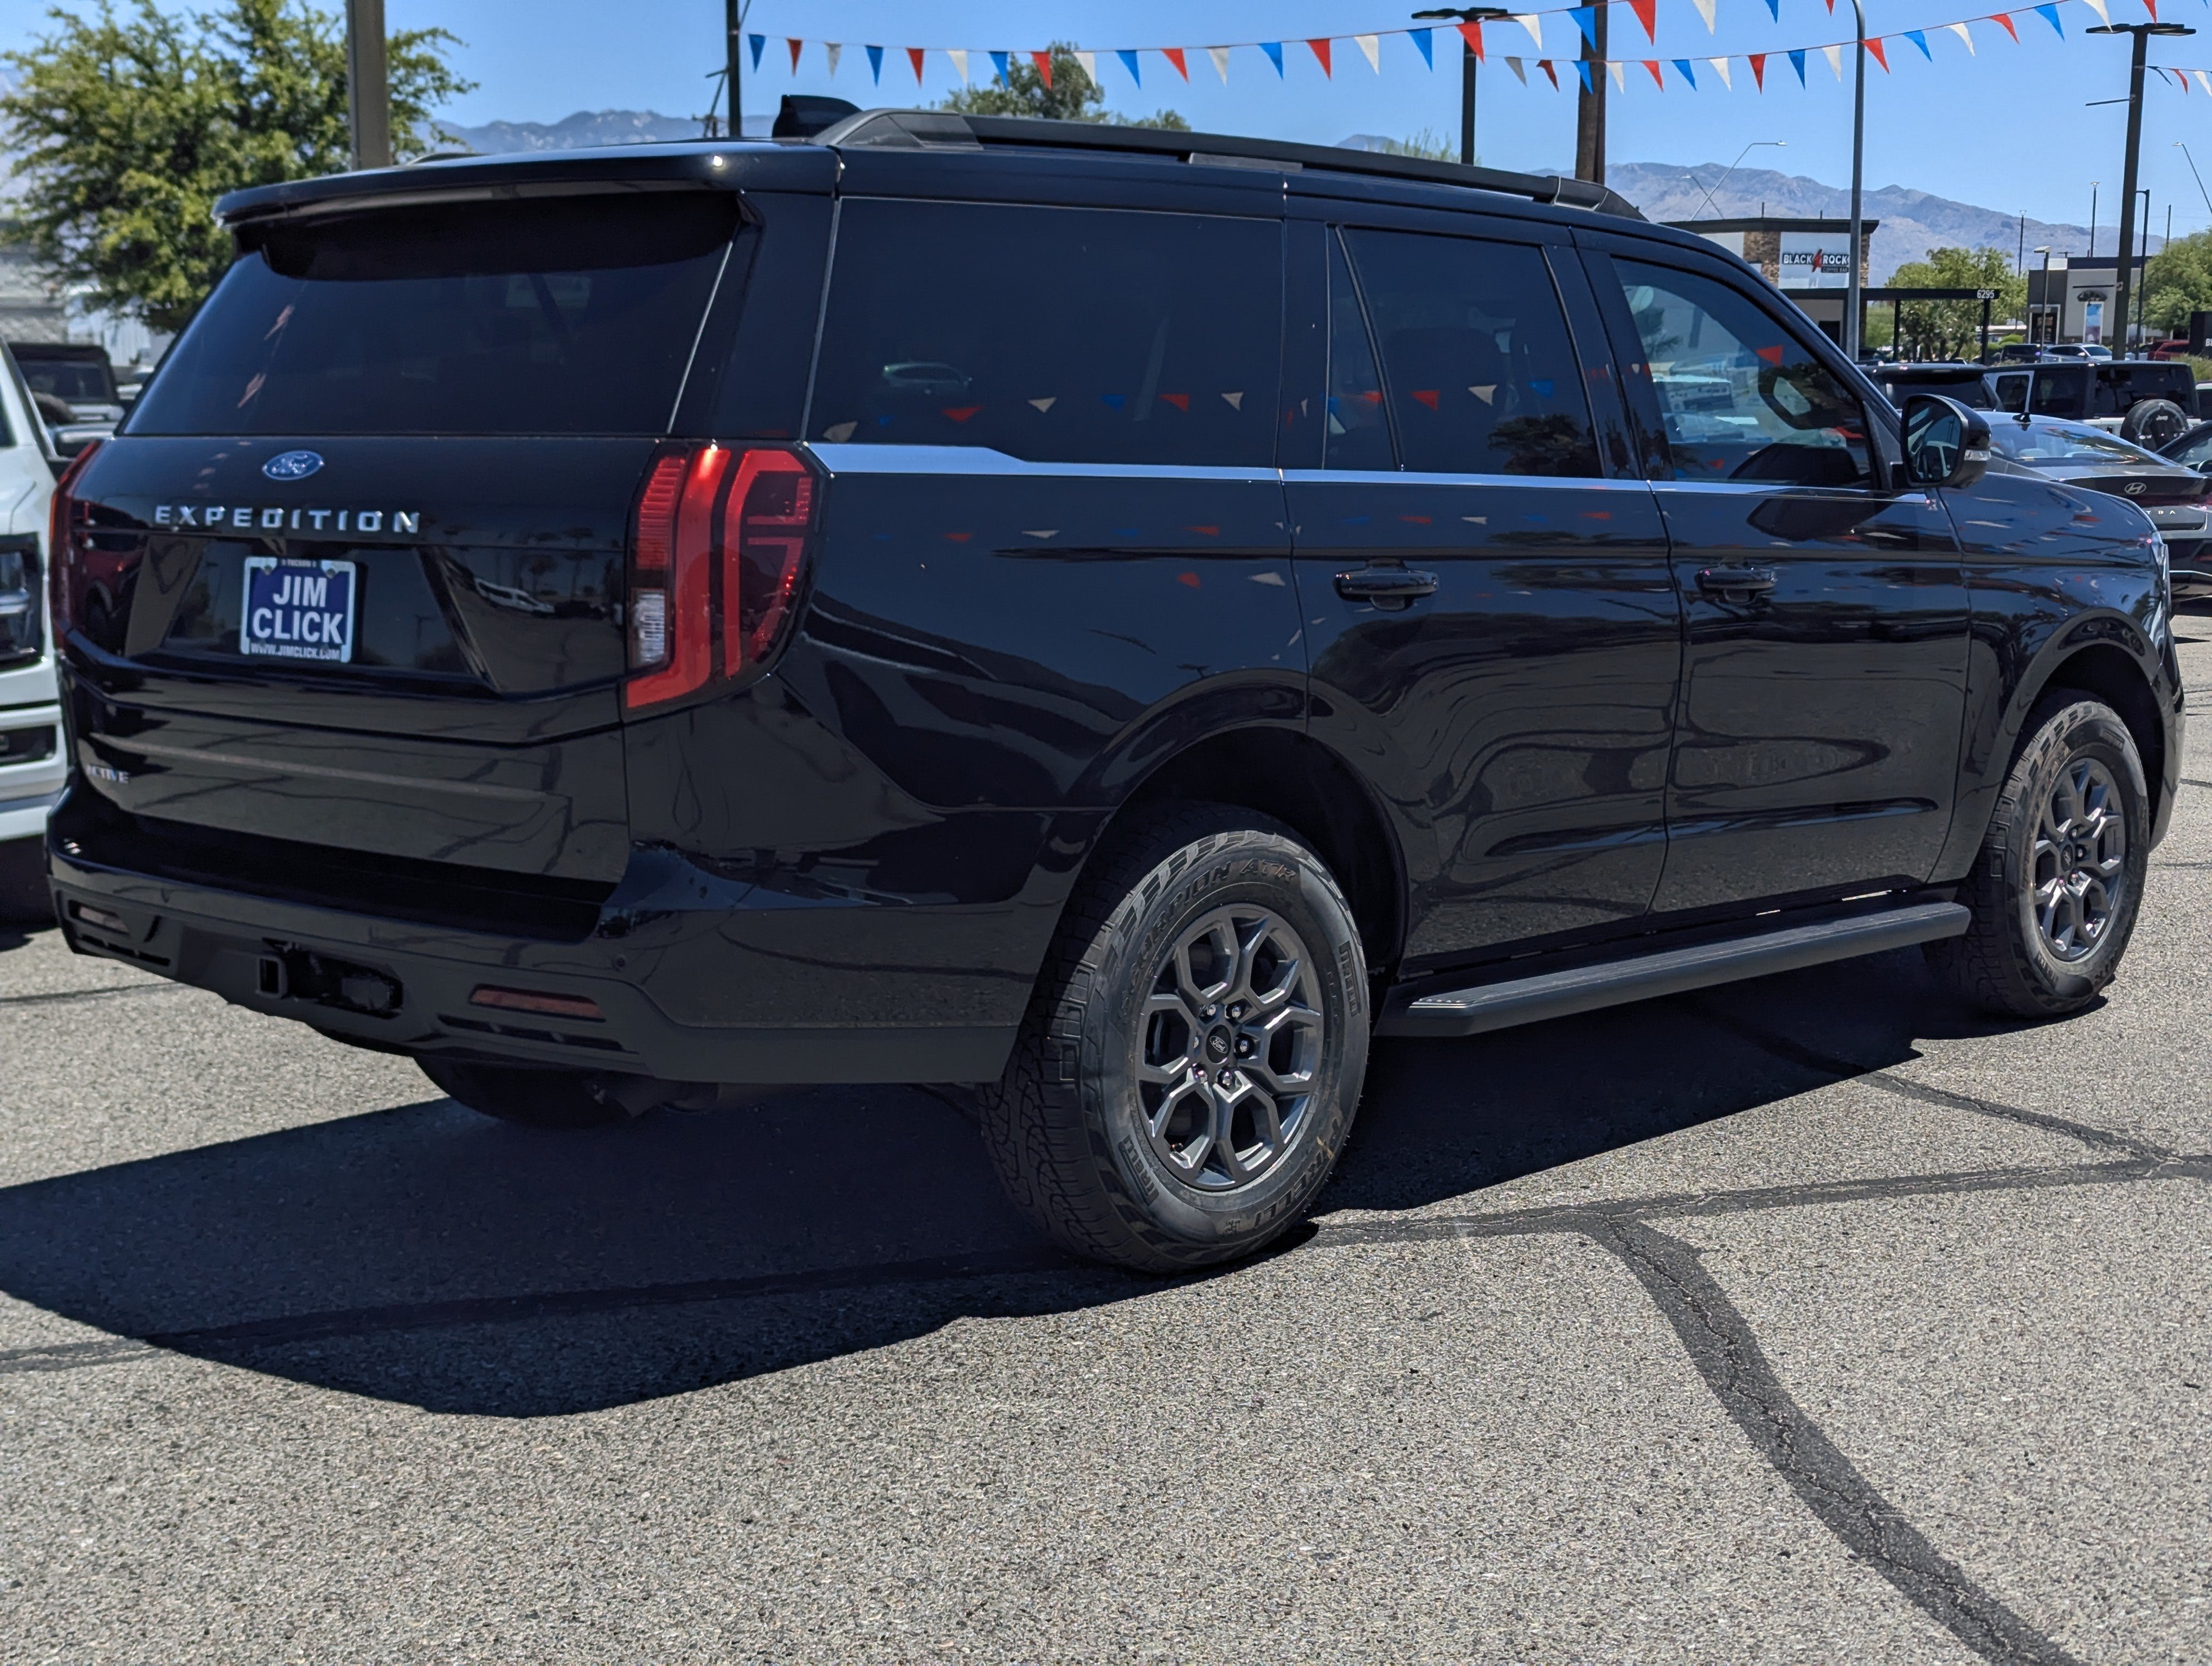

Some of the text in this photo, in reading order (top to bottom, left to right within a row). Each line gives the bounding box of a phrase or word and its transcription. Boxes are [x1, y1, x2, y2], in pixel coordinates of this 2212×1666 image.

[1784, 254, 1848, 265] BLACK ROCK
[1977, 289, 1995, 299] 6295
[155, 505, 420, 534] EXPEDITION
[273, 575, 327, 607] JIM
[252, 607, 344, 644] CLICK
[1240, 858, 1296, 883] ATR
